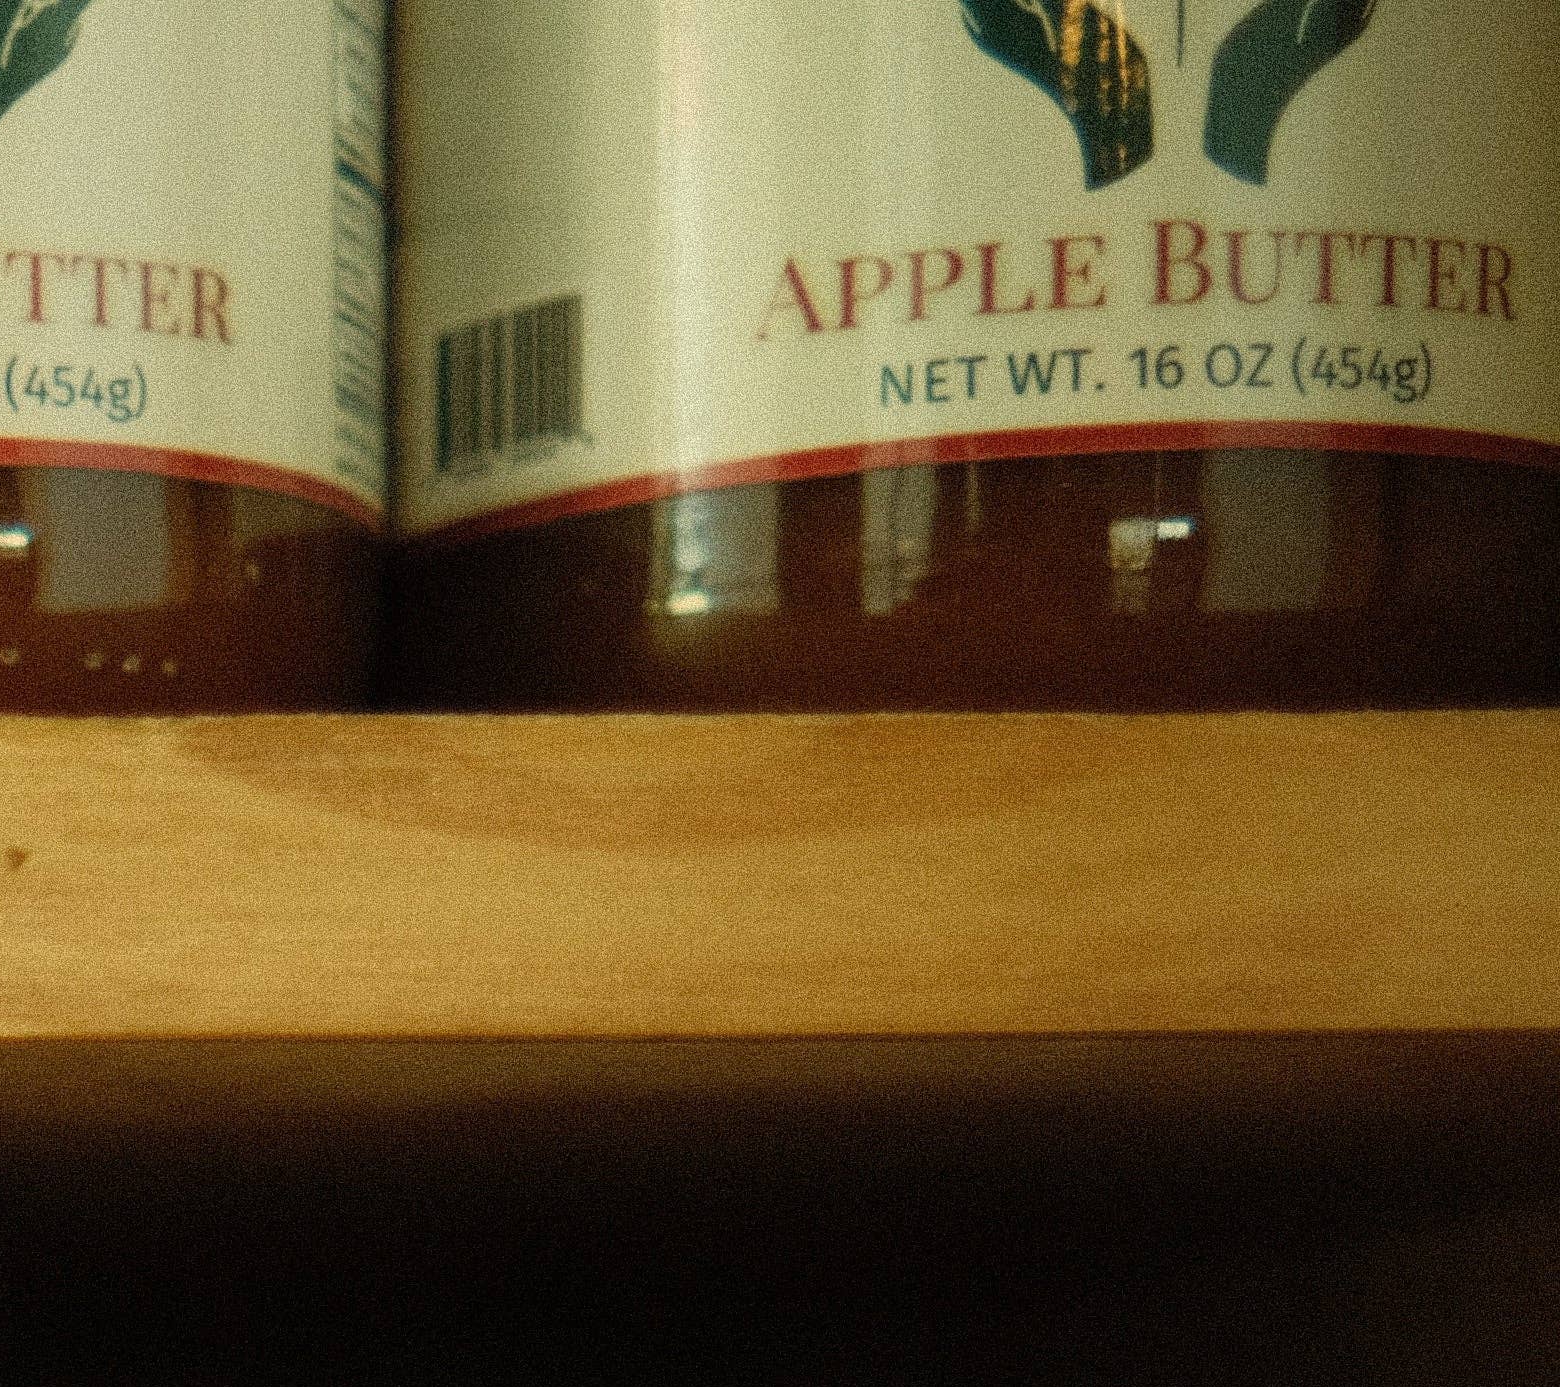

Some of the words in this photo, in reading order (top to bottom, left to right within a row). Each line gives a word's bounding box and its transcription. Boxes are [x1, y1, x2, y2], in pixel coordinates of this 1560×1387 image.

[758, 235, 1107, 340] APPLE
[1149, 219, 1519, 323] BUTTER
[4, 360, 149, 420] (454g)
[879, 355, 987, 406] NET
[1009, 349, 1105, 396] WT.
[1129, 346, 1183, 390] 16
[1206, 343, 1274, 388] OZ
[1292, 338, 1433, 401] (454g)
